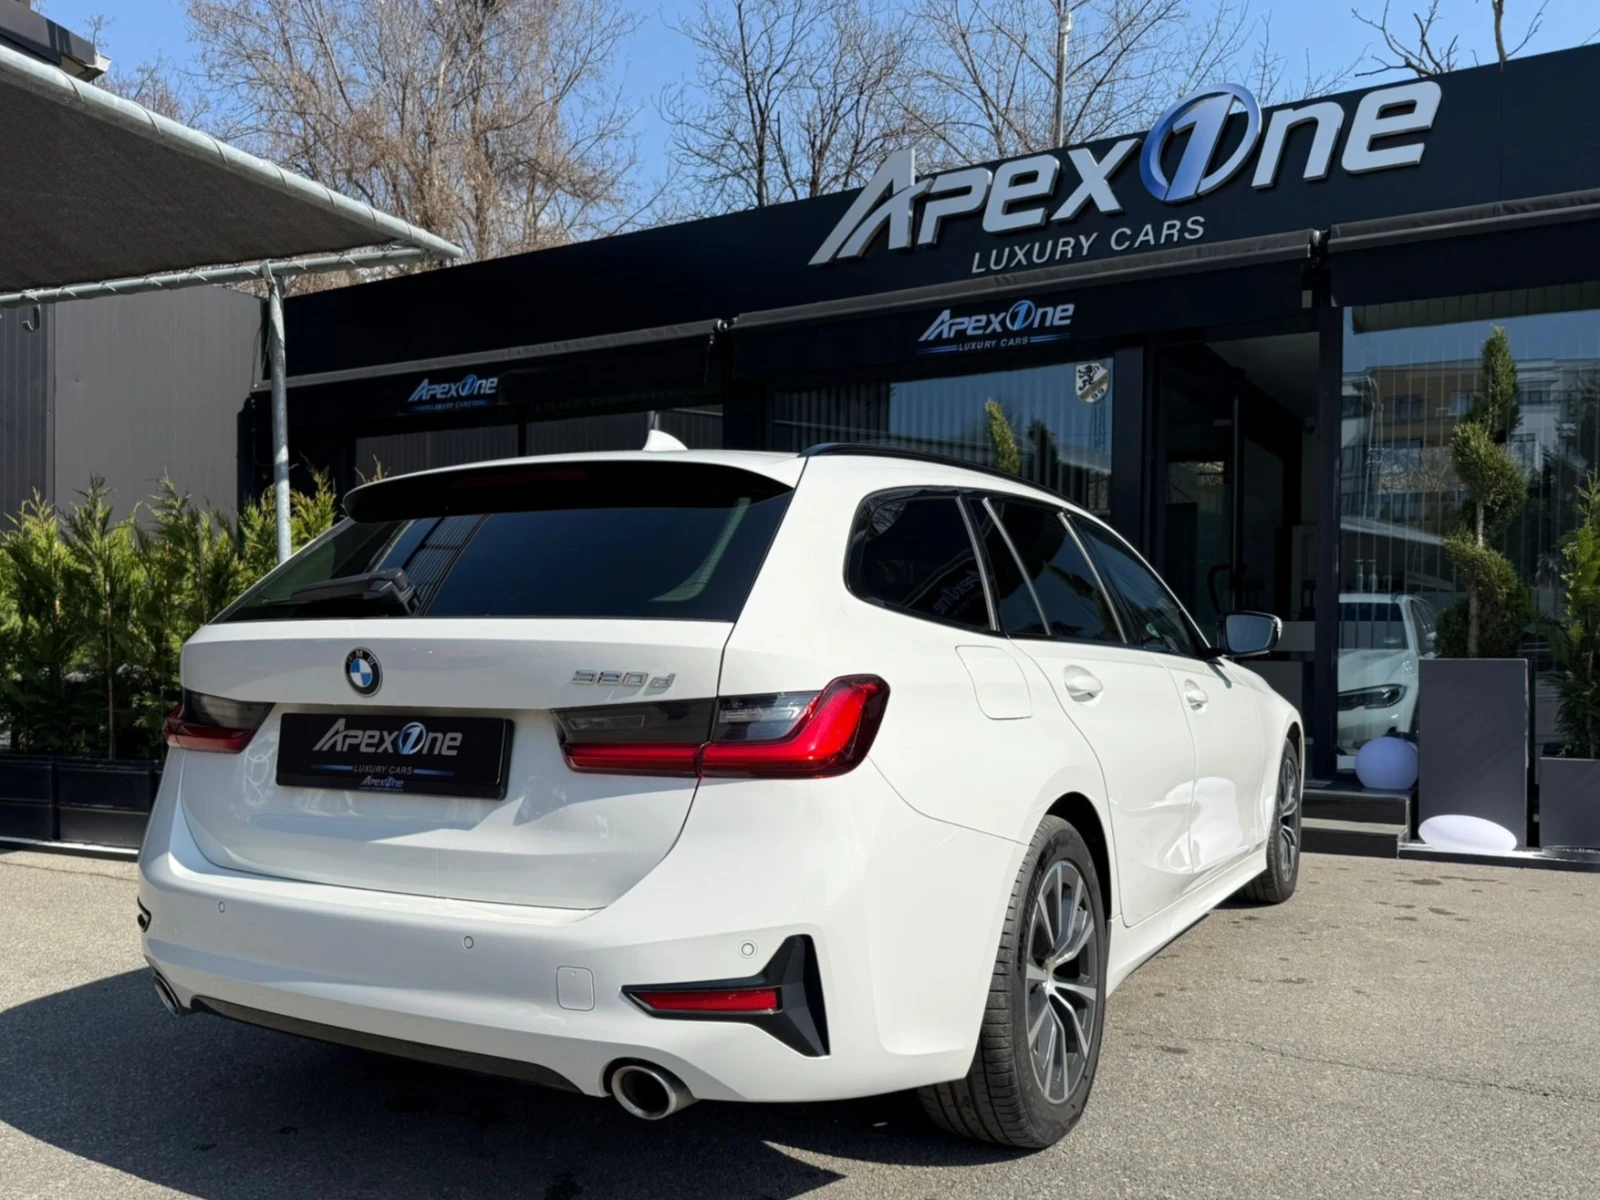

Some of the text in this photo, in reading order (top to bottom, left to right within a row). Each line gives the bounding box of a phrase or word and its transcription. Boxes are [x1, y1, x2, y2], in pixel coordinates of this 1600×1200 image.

[971, 215, 1206, 274] LUXURY CARS
[958, 336, 1029, 352] LUXURY CARS
[572, 669, 677, 688] 320d
[354, 765, 413, 775] LUXURY CARS
